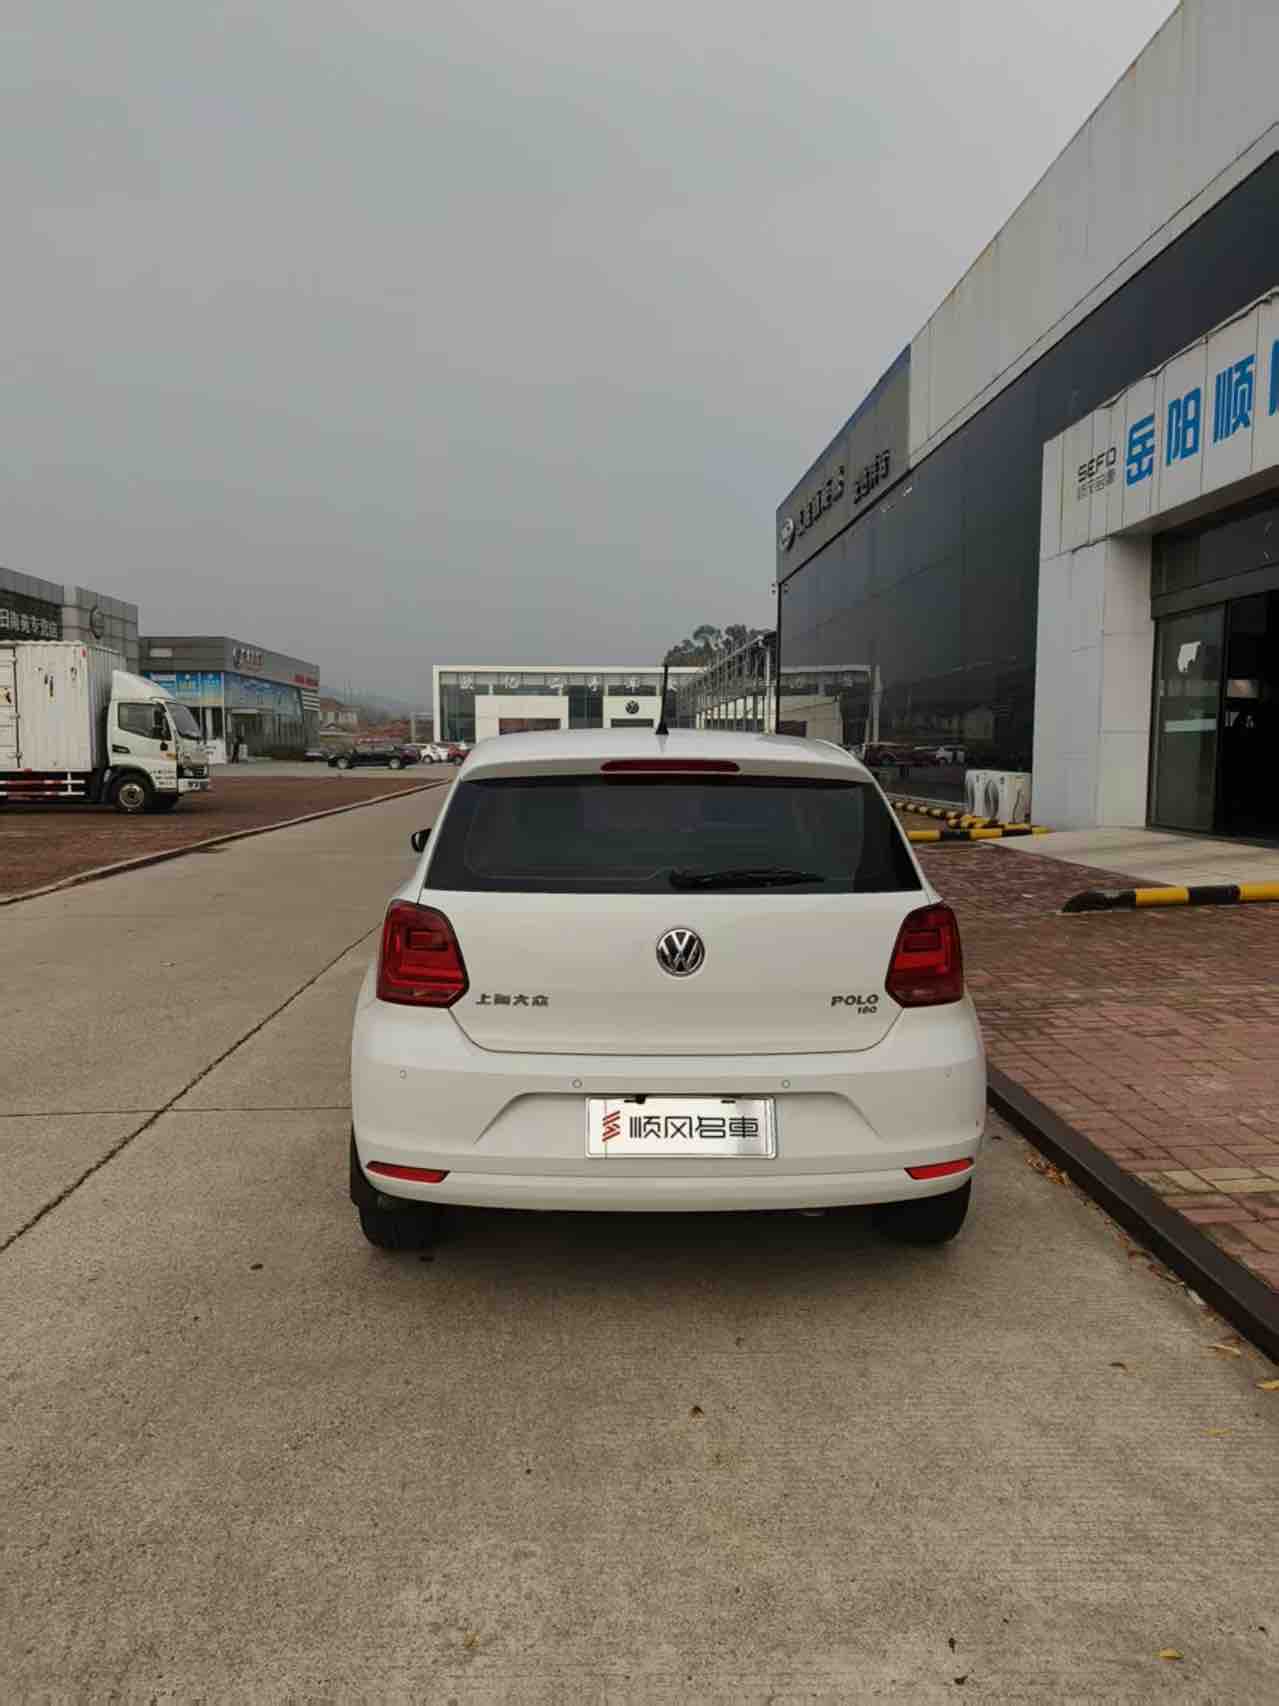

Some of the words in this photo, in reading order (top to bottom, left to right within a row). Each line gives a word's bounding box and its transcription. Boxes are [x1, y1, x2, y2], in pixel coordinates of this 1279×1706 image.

[1126, 337, 1279, 487] 岳阳顺
[831, 994, 879, 1007] POLO
[629, 1115, 759, 1139] 顺风名車
